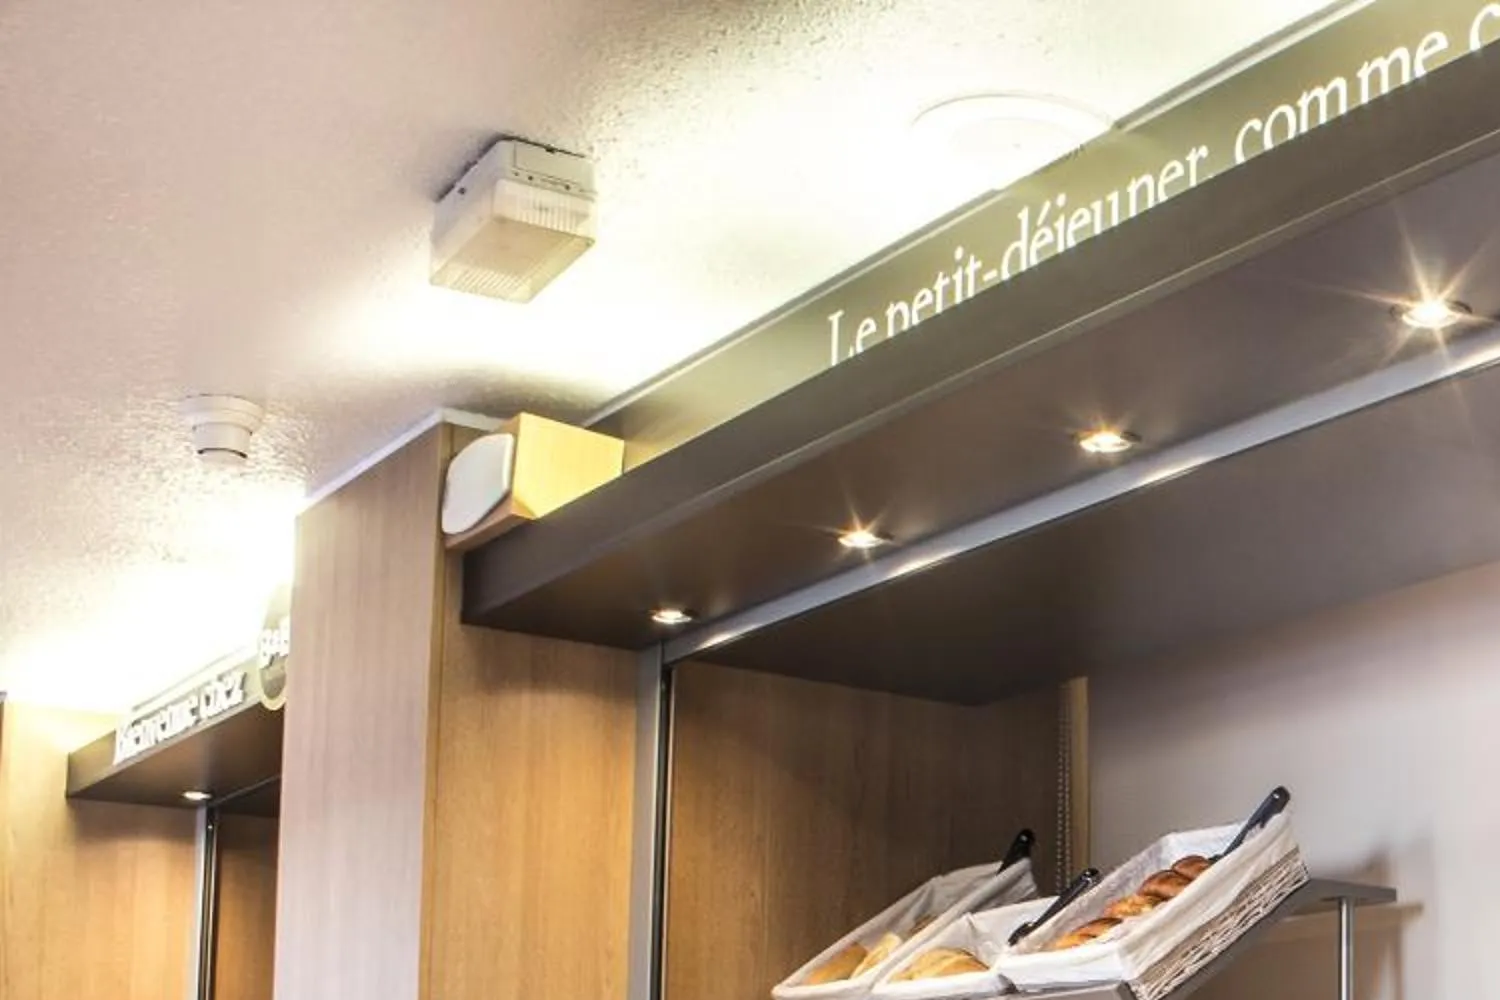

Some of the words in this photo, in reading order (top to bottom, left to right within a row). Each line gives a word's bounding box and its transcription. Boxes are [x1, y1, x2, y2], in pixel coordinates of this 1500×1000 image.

[828, 310, 877, 366] Le
[886, 145, 1212, 338] petit-déjeuner
[1234, 31, 1449, 165] comme
